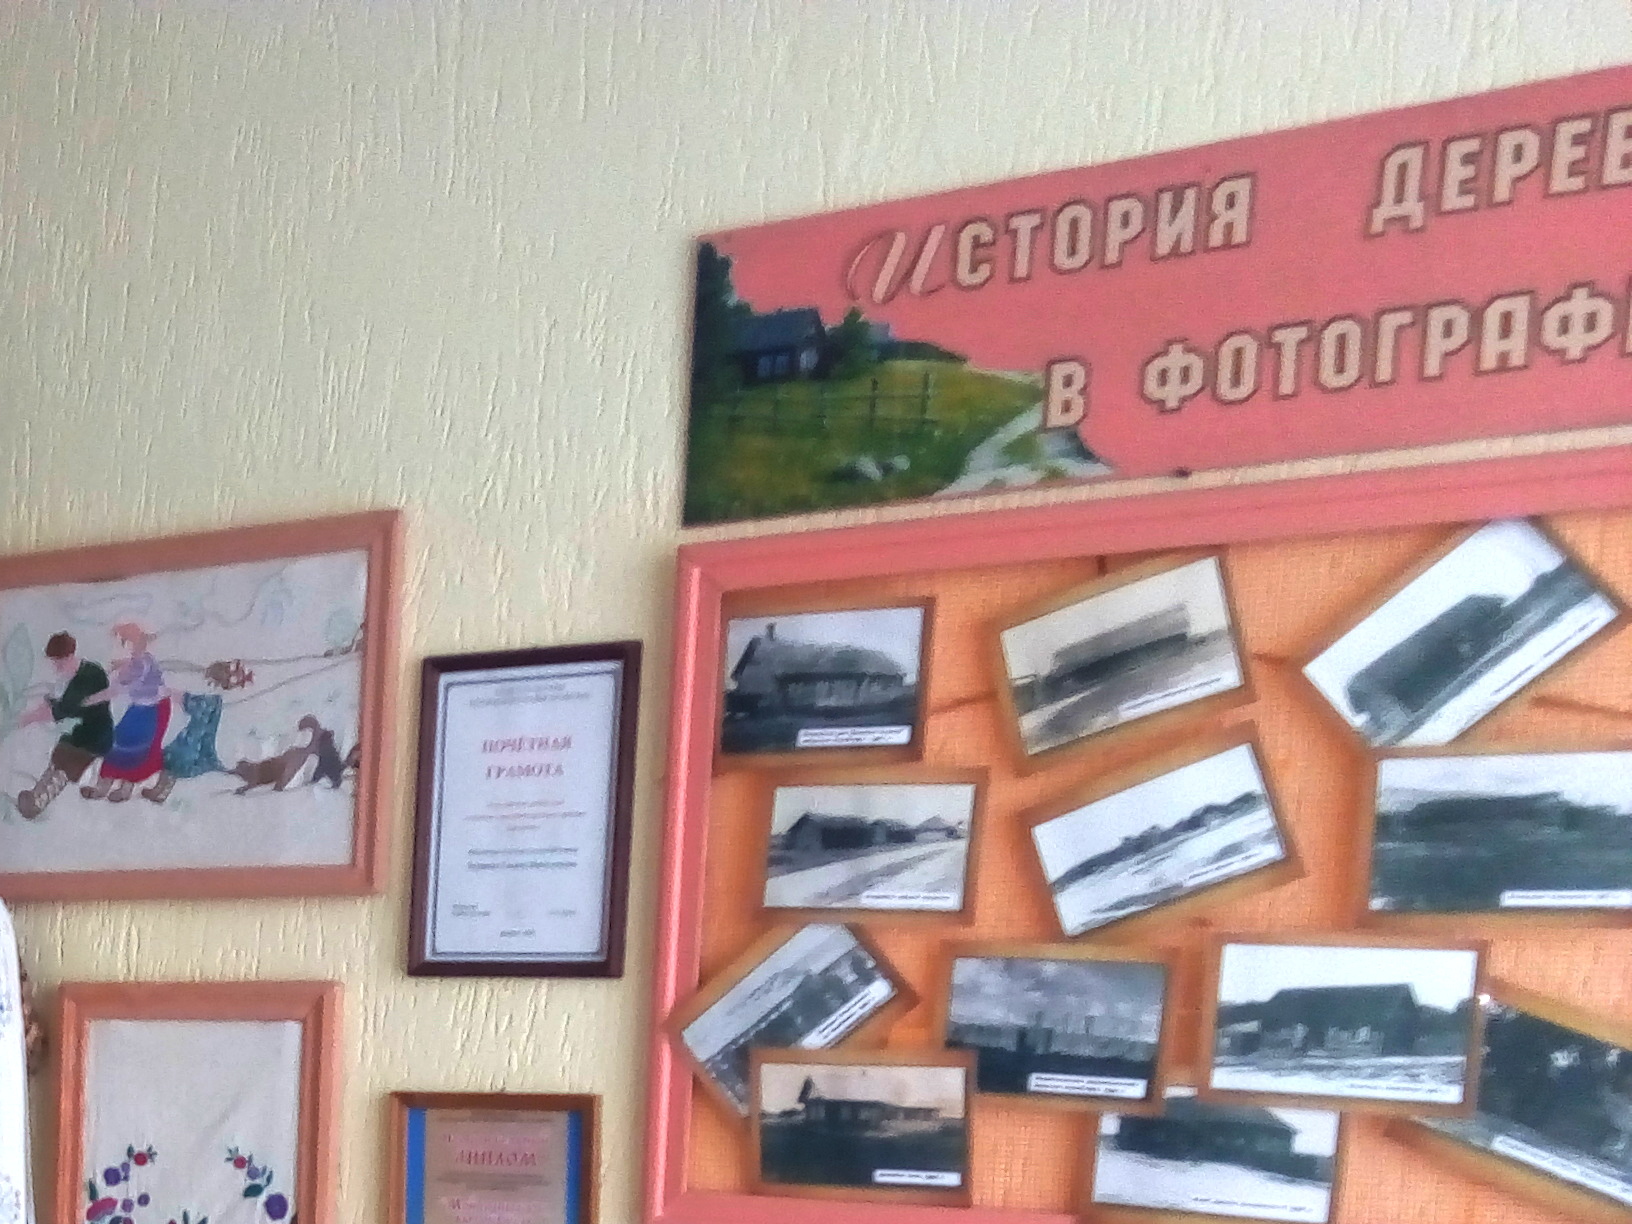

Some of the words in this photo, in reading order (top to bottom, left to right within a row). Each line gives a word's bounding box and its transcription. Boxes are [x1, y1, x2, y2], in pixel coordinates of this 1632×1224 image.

[845, 171, 1257, 306] ИСТОРИЯ
[1043, 354, 1090, 431] В
[1140, 278, 1632, 412] ФОТОГРАФ
